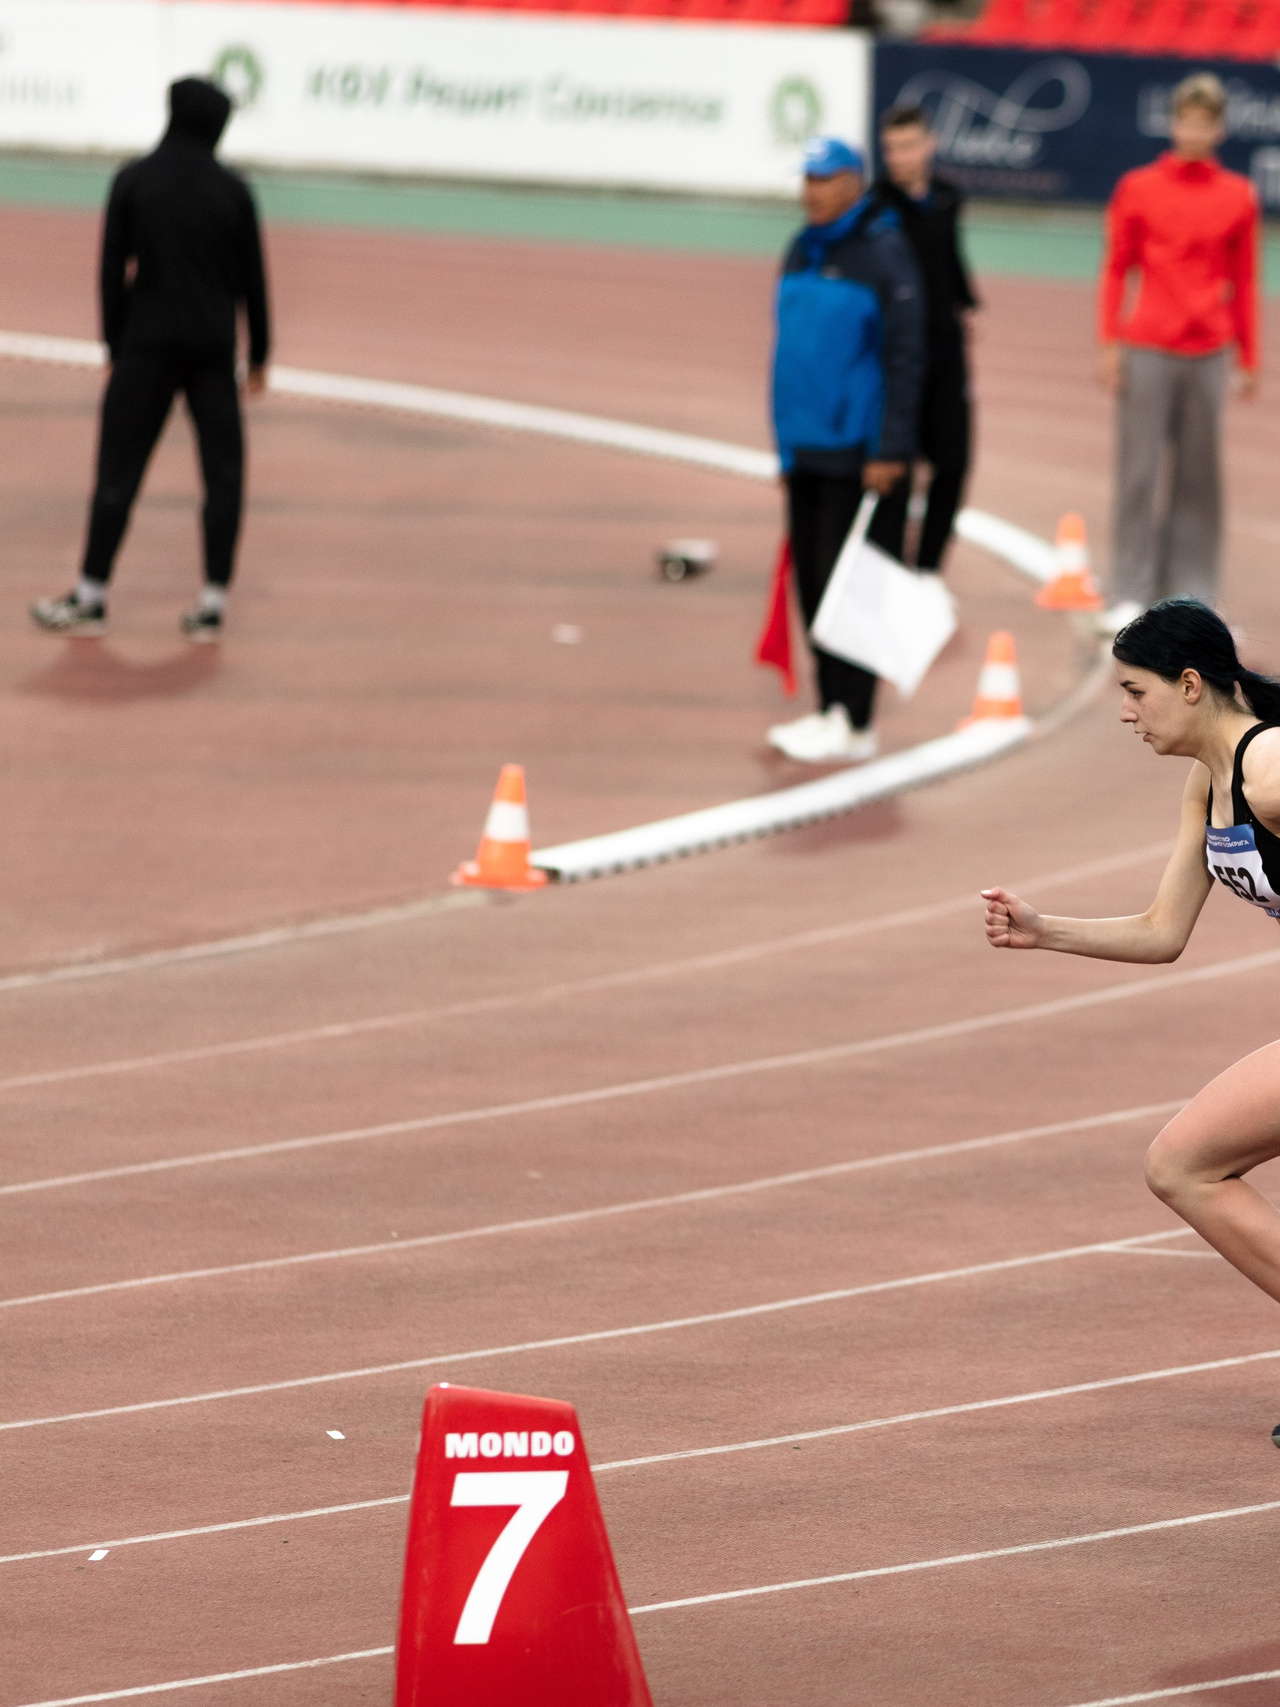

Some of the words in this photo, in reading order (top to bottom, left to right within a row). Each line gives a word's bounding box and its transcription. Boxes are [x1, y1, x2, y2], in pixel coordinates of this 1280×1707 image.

[1212, 864, 1270, 903] 552
[444, 1430, 575, 1459] MONDO
[449, 1469, 570, 1645] 7
